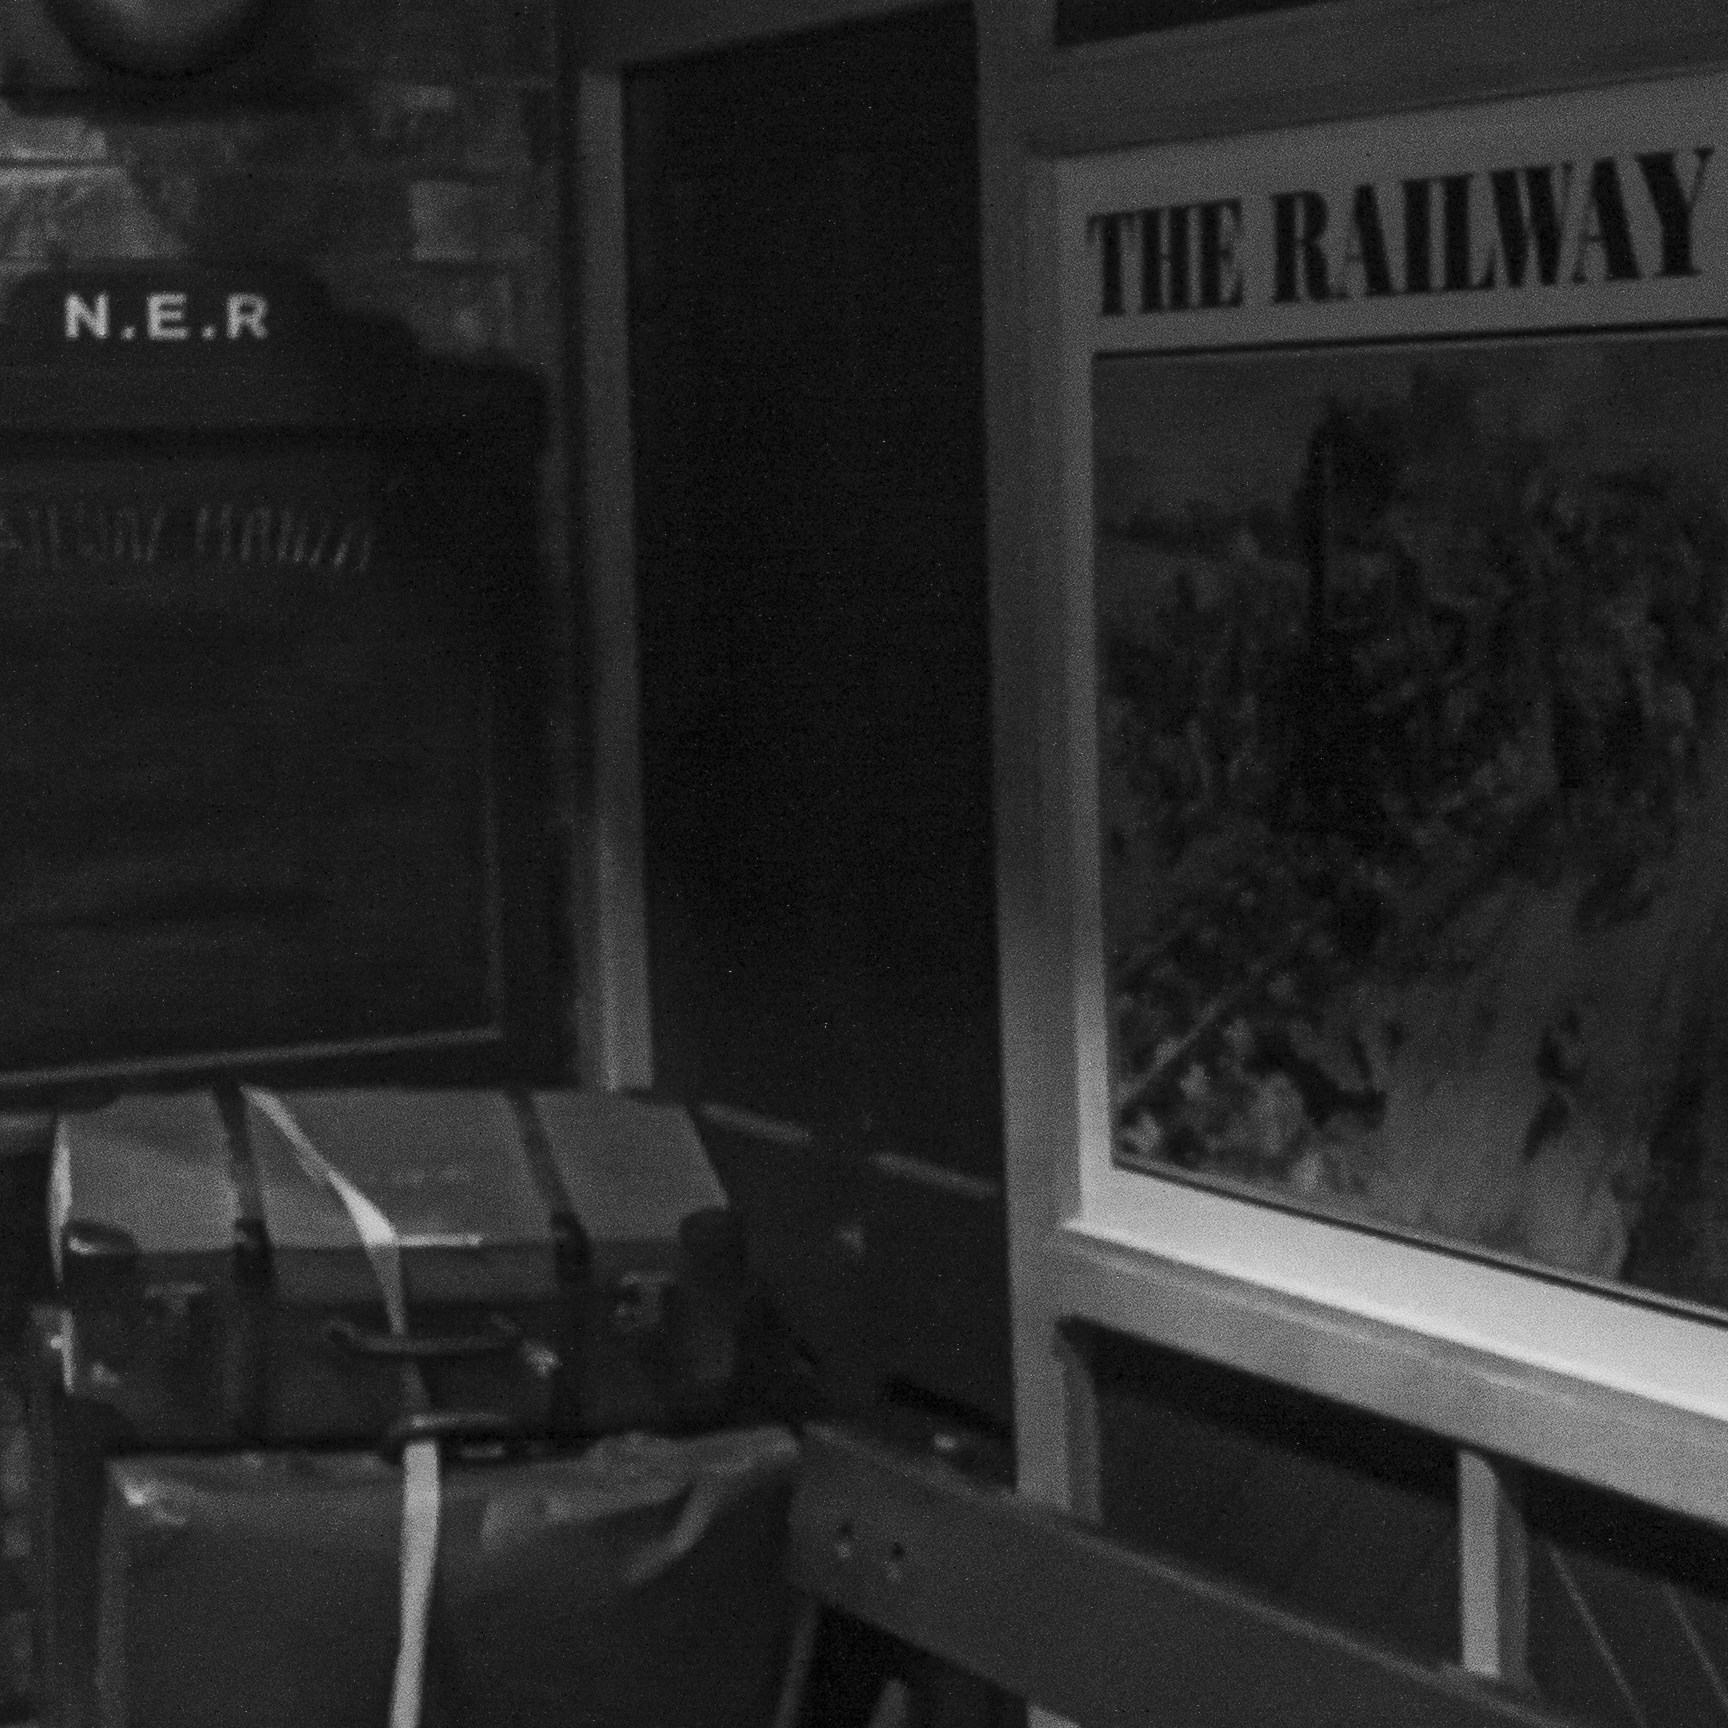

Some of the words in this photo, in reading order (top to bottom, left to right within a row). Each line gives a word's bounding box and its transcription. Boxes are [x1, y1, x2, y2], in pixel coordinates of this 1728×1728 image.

[1085, 197, 1243, 317] THE
[1271, 146, 1716, 306] RAILWAY
[64, 293, 270, 340] N.E.R
